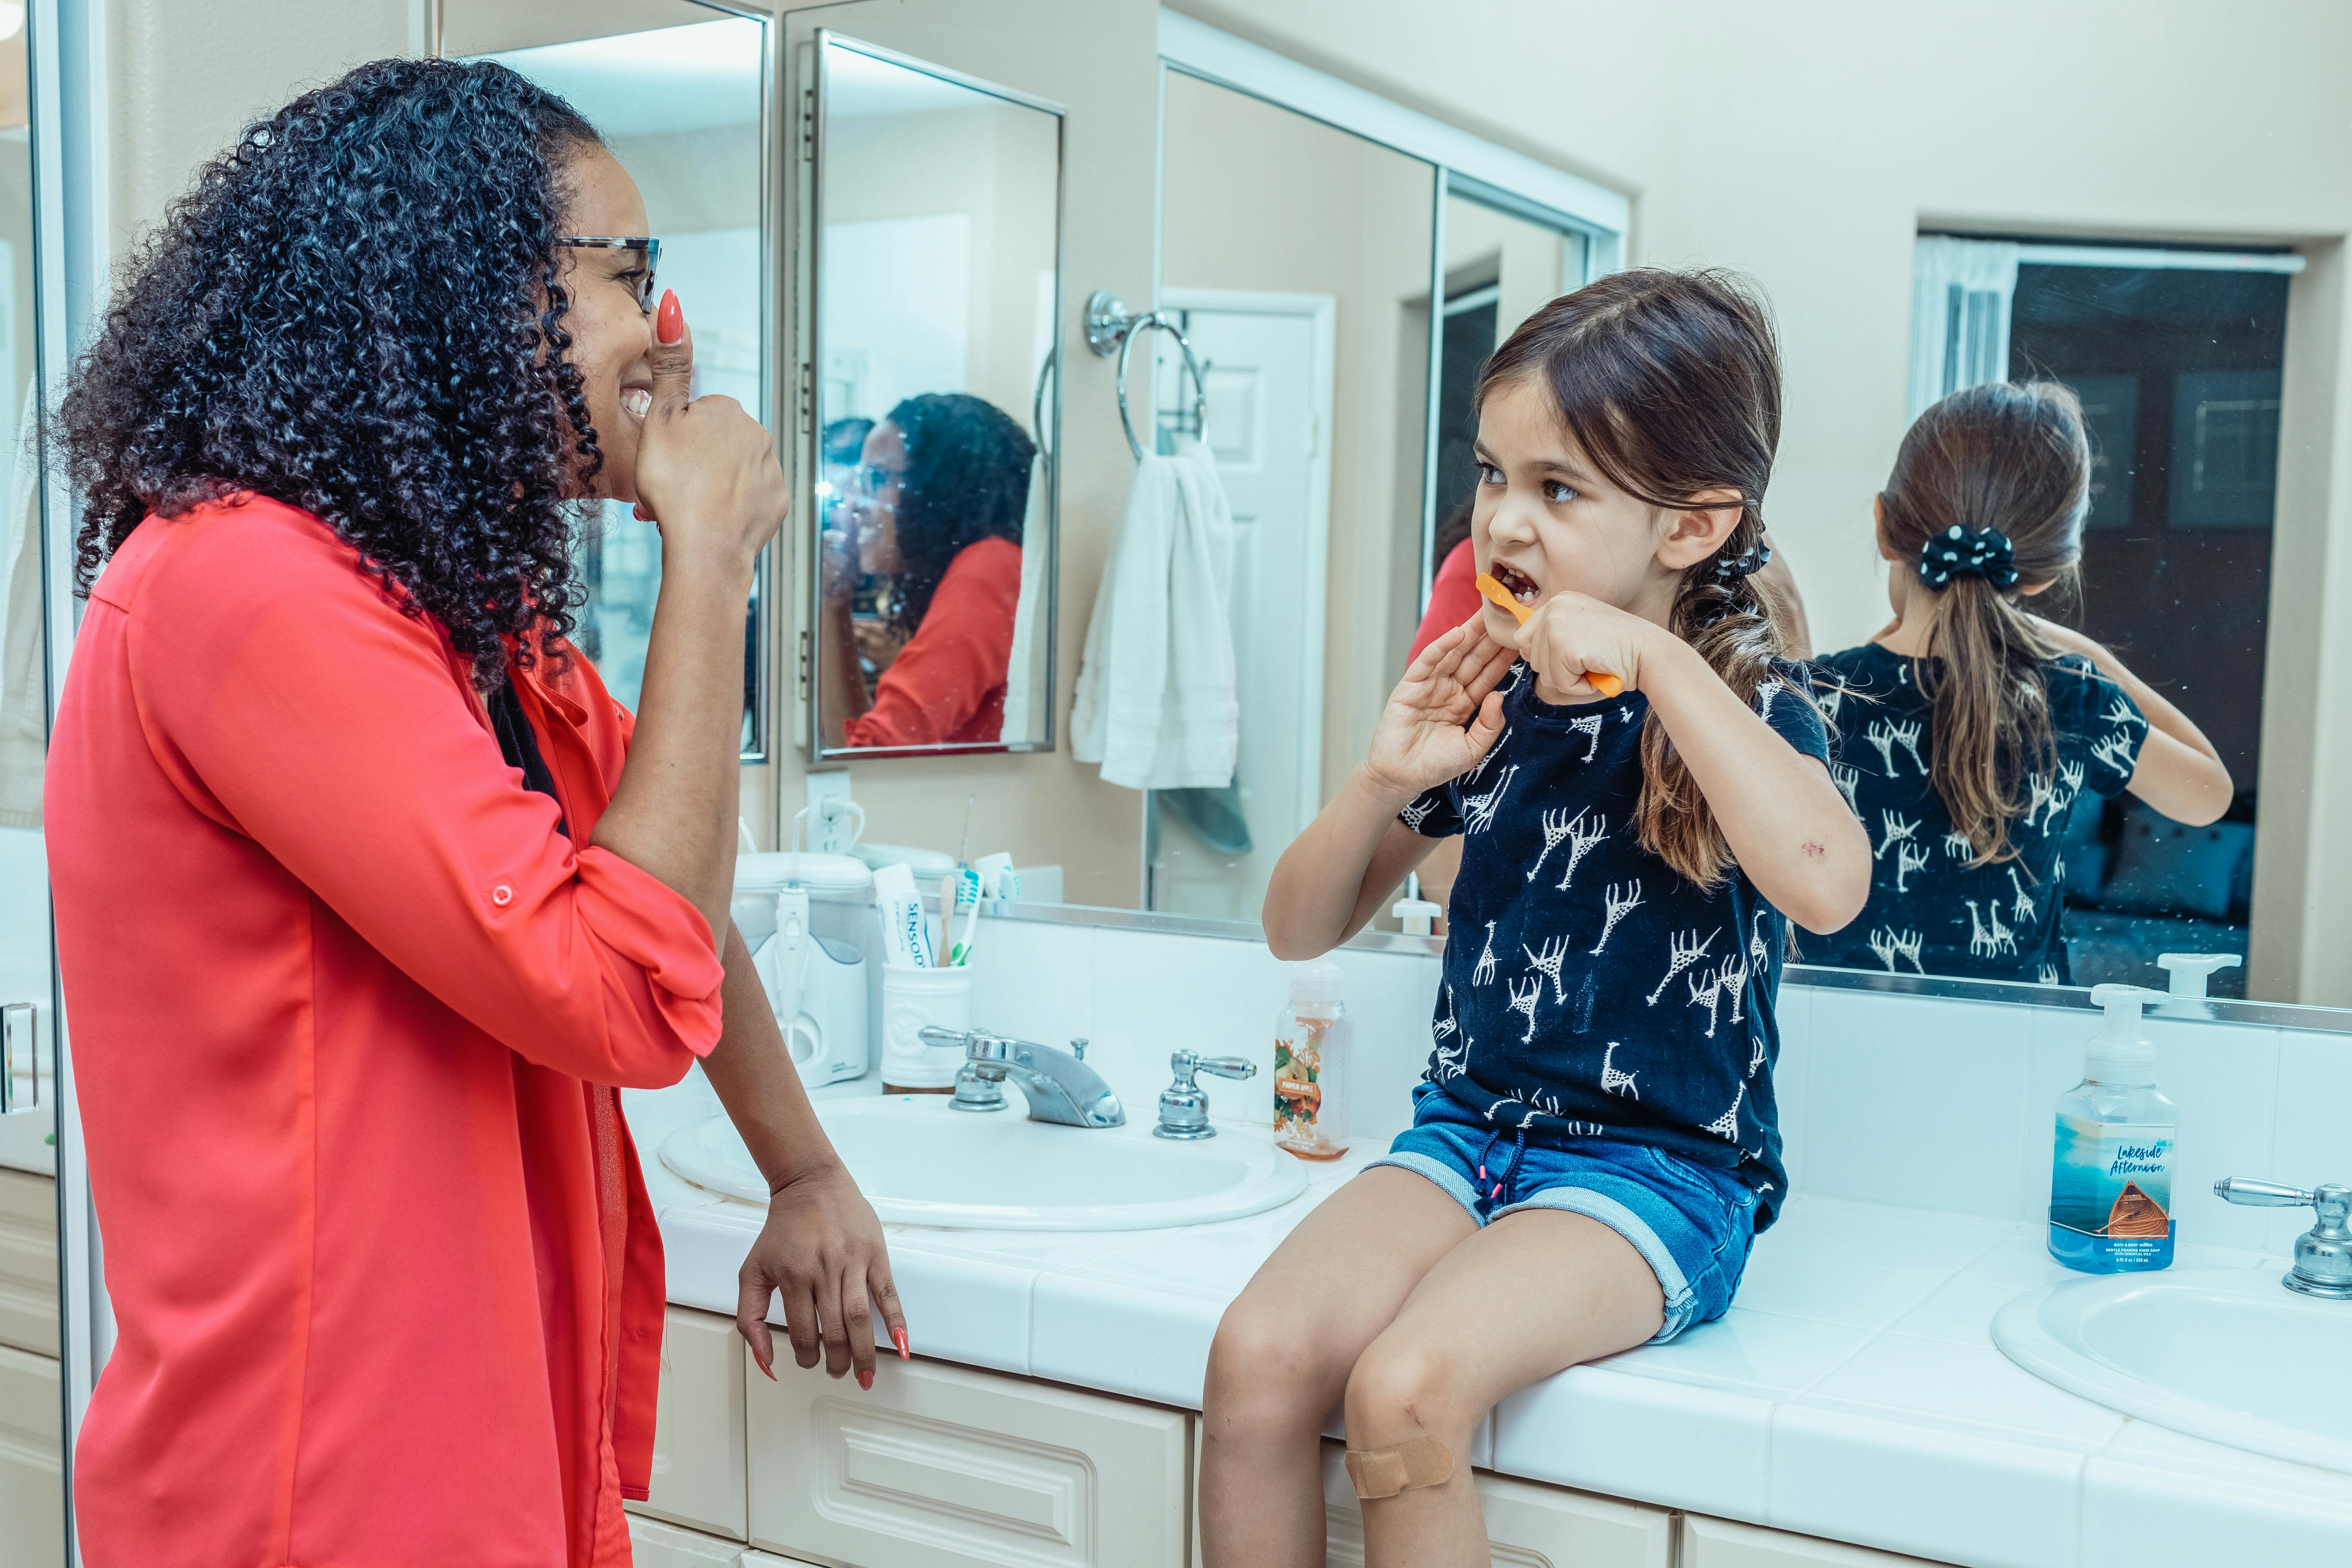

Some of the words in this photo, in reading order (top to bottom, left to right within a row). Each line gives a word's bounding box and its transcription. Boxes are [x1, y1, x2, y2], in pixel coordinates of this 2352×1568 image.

[909, 903, 925, 967] SENSOD
[2118, 1145, 2163, 1161] Lakeside
[2110, 1160, 2165, 1176] Afternoon
